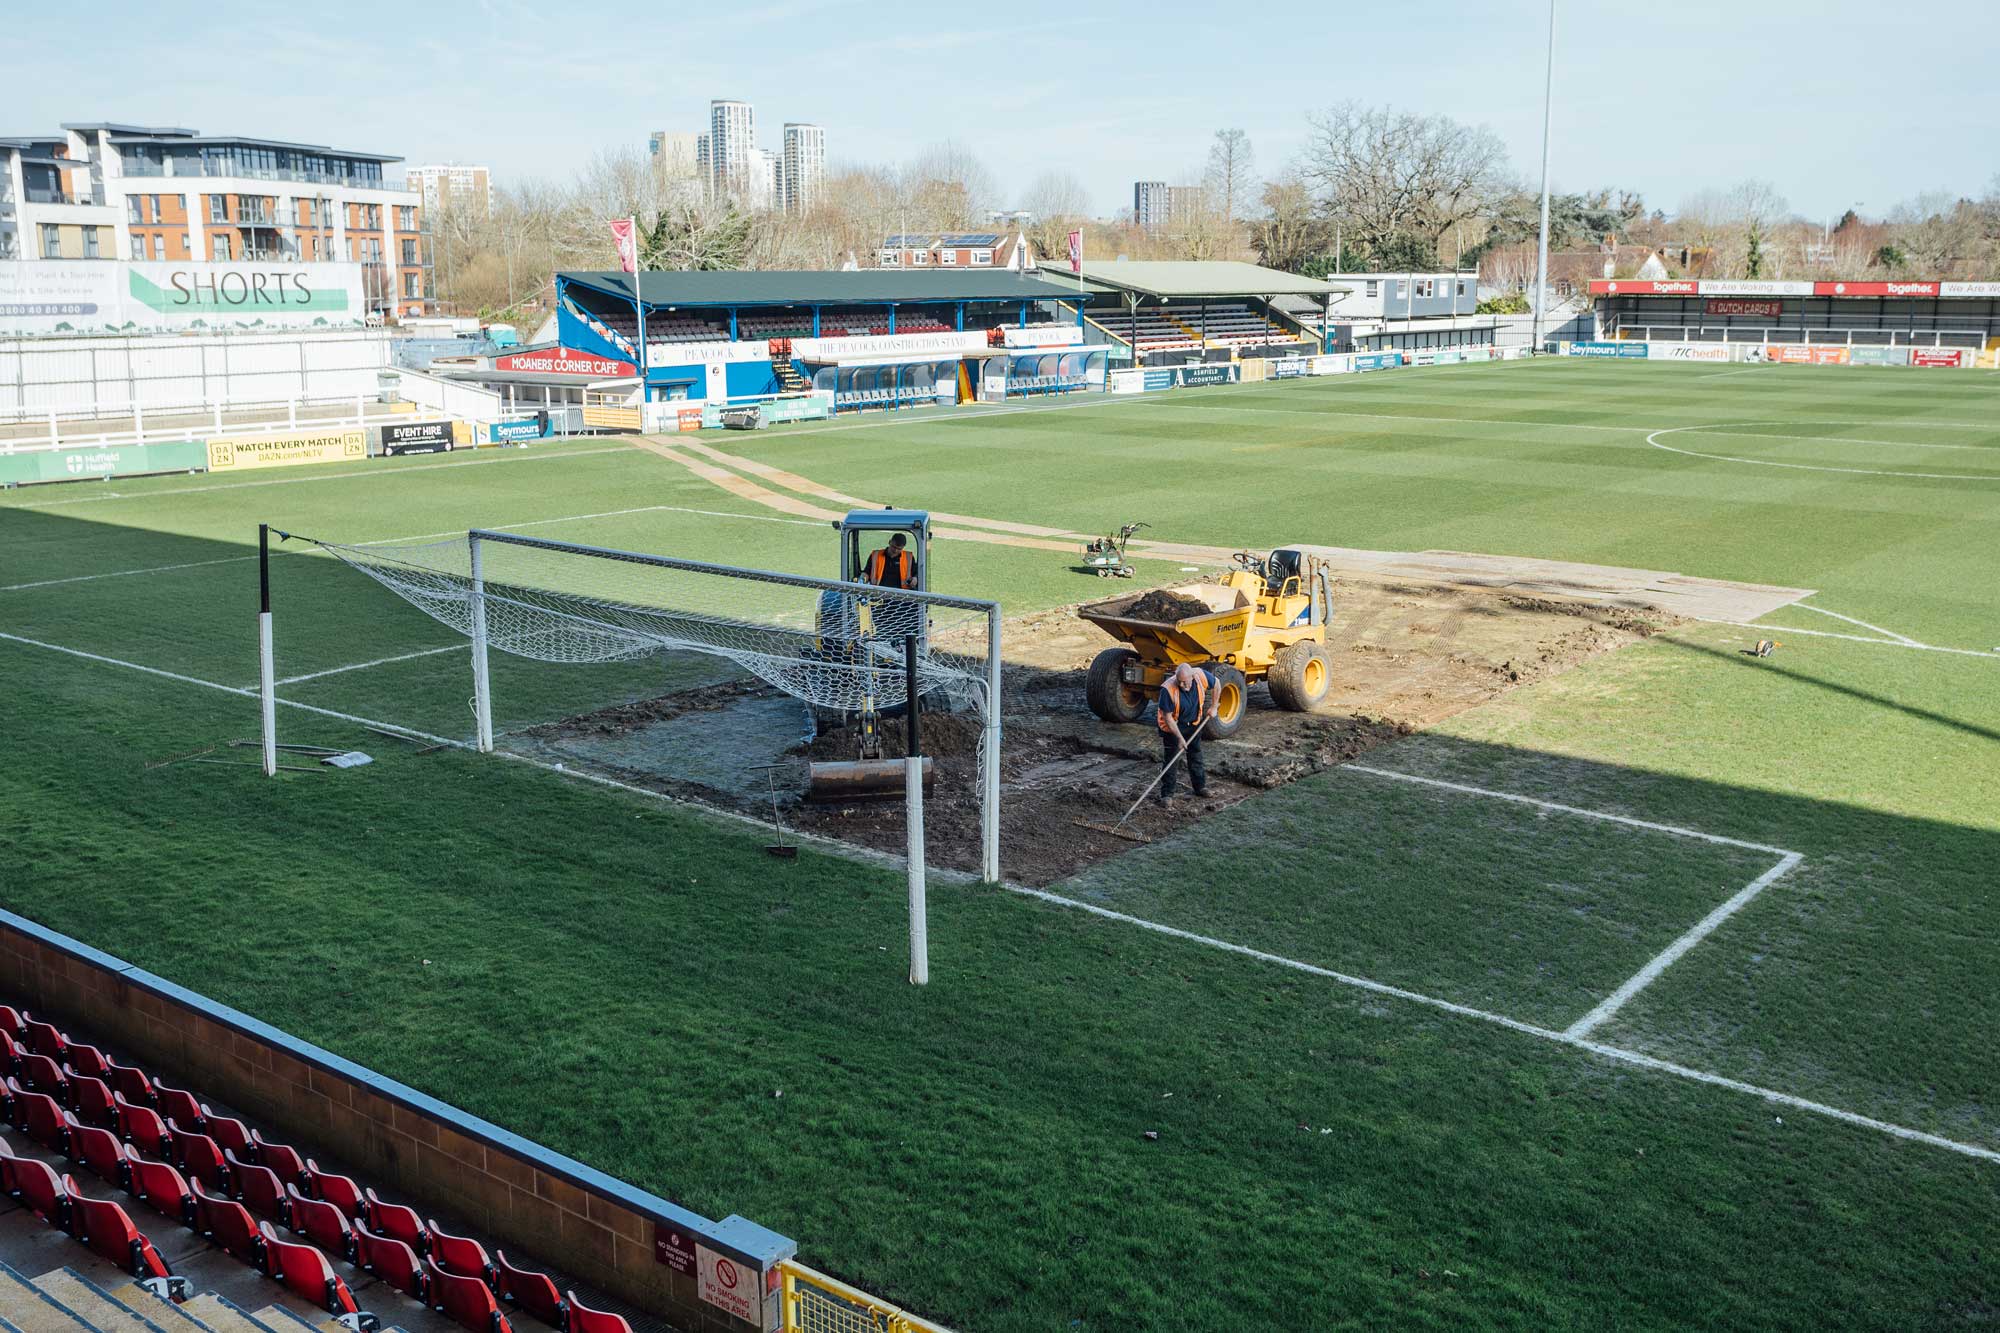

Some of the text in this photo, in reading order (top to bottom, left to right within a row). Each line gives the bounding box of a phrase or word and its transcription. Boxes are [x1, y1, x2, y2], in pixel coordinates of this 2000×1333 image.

[170, 271, 312, 305] SHORTS
[62, 305, 80, 314] 400
[1717, 302, 1770, 315] DUTCH CARDS
[818, 337, 966, 354] THE PEACOCK CONSTRUCTION STAND
[1570, 343, 1616, 356] Seymours
[685, 347, 735, 360] PEACOCK
[554, 359, 593, 373] CORNER
[1193, 368, 1218, 376] ASHFIELD
[1188, 375, 1224, 383] ACCOUNTANCY
[394, 425, 442, 438] EVENT HIRE
[236, 437, 341, 453] WATCH EVERY MATCH
[705, 1281, 750, 1309] NO SMOKING
[705, 1293, 751, 1320] IN THIS AREA
